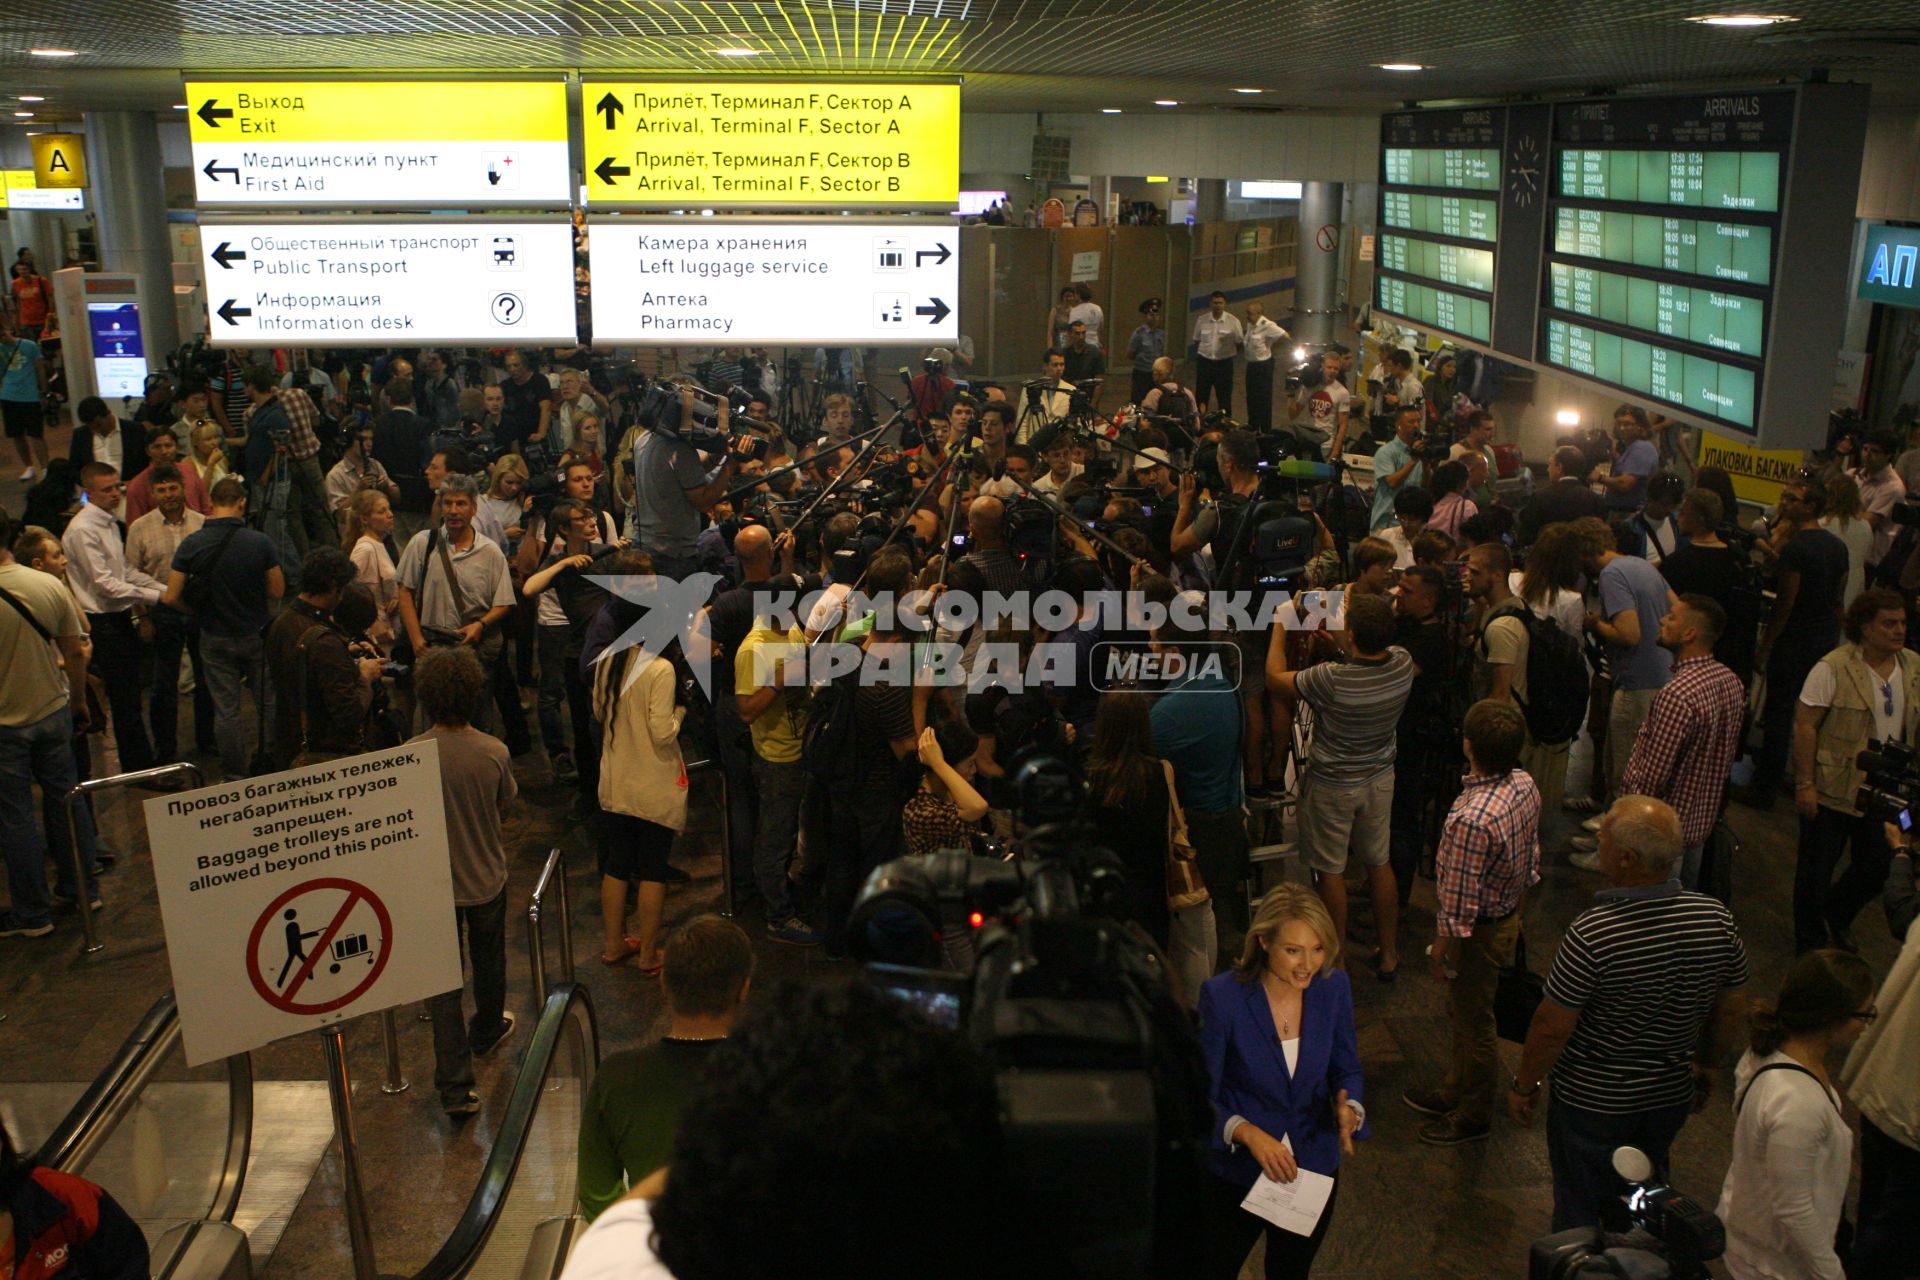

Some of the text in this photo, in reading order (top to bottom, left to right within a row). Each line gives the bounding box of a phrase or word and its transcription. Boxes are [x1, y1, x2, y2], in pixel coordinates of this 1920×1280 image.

[238, 93, 304, 111] Выход
[634, 92, 707, 111] Прилёт,
[712, 94, 804, 111] Терминал
[826, 94, 893, 111] Сектор
[1704, 96, 1760, 116] ARRIVALS
[240, 118, 276, 134] Exit
[636, 118, 704, 134] Arrival,
[711, 118, 792, 134] Terminal
[820, 120, 881, 134] Sector
[887, 120, 900, 134] A
[243, 151, 438, 170] Медицинский пункт
[636, 152, 708, 169] Прилёт,
[712, 152, 804, 169] Терминал
[827, 153, 892, 169] Сектор
[246, 176, 324, 192] First Aid
[638, 176, 705, 192] Arrival,
[711, 176, 792, 192] Terminal
[820, 177, 882, 192] Sector
[888, 178, 900, 192] B
[1722, 194, 1755, 208] Задержан
[1716, 224, 1750, 238] Совмещен
[250, 236, 479, 252] Общественный транспорт
[638, 236, 807, 252] Камера хранения
[253, 260, 408, 276] Public Transport
[640, 260, 828, 277] Left luggage service
[1716, 265, 1748, 280] Совмещен
[256, 292, 381, 309] Информация
[642, 292, 708, 307] Аптека
[1709, 294, 1741, 309] Задержан
[258, 314, 414, 330] Information desk
[642, 315, 733, 332] Pharmacy
[1708, 334, 1741, 352] Совмещен
[1702, 388, 1734, 406] Совмещен
[1704, 448, 1752, 474] УПАКОВКА
[168, 752, 421, 816] Провоз багажных тележек,
[200, 776, 398, 829] негабаритных грузов
[252, 807, 352, 837] запрещен.
[196, 808, 414, 870] Baggage trolleys are not
[189, 830, 420, 892] allowed beyond this point.
